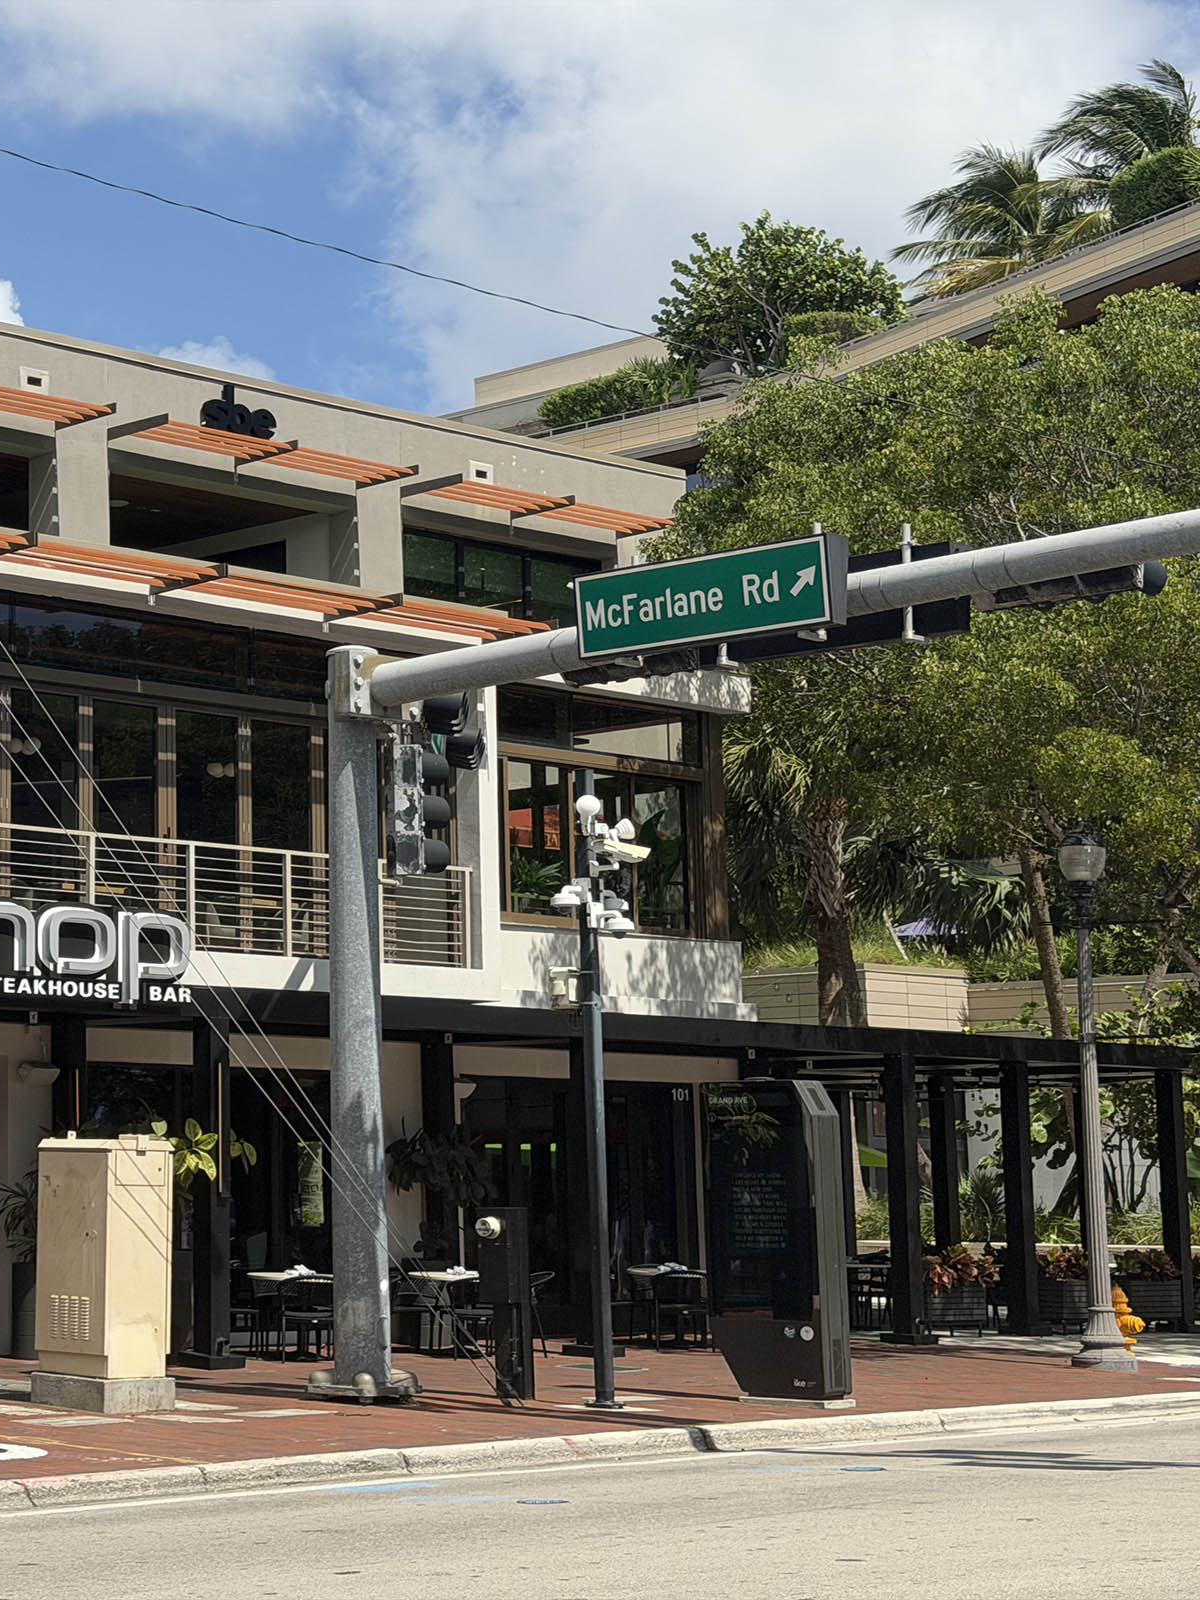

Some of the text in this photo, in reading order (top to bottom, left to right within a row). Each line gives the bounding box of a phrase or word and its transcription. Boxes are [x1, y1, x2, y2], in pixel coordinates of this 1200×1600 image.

[200, 384, 277, 440] sbe
[585, 569, 780, 631] McFarlane Rd
[149, 985, 192, 1003] BAR
[671, 1087, 690, 1101] 101
